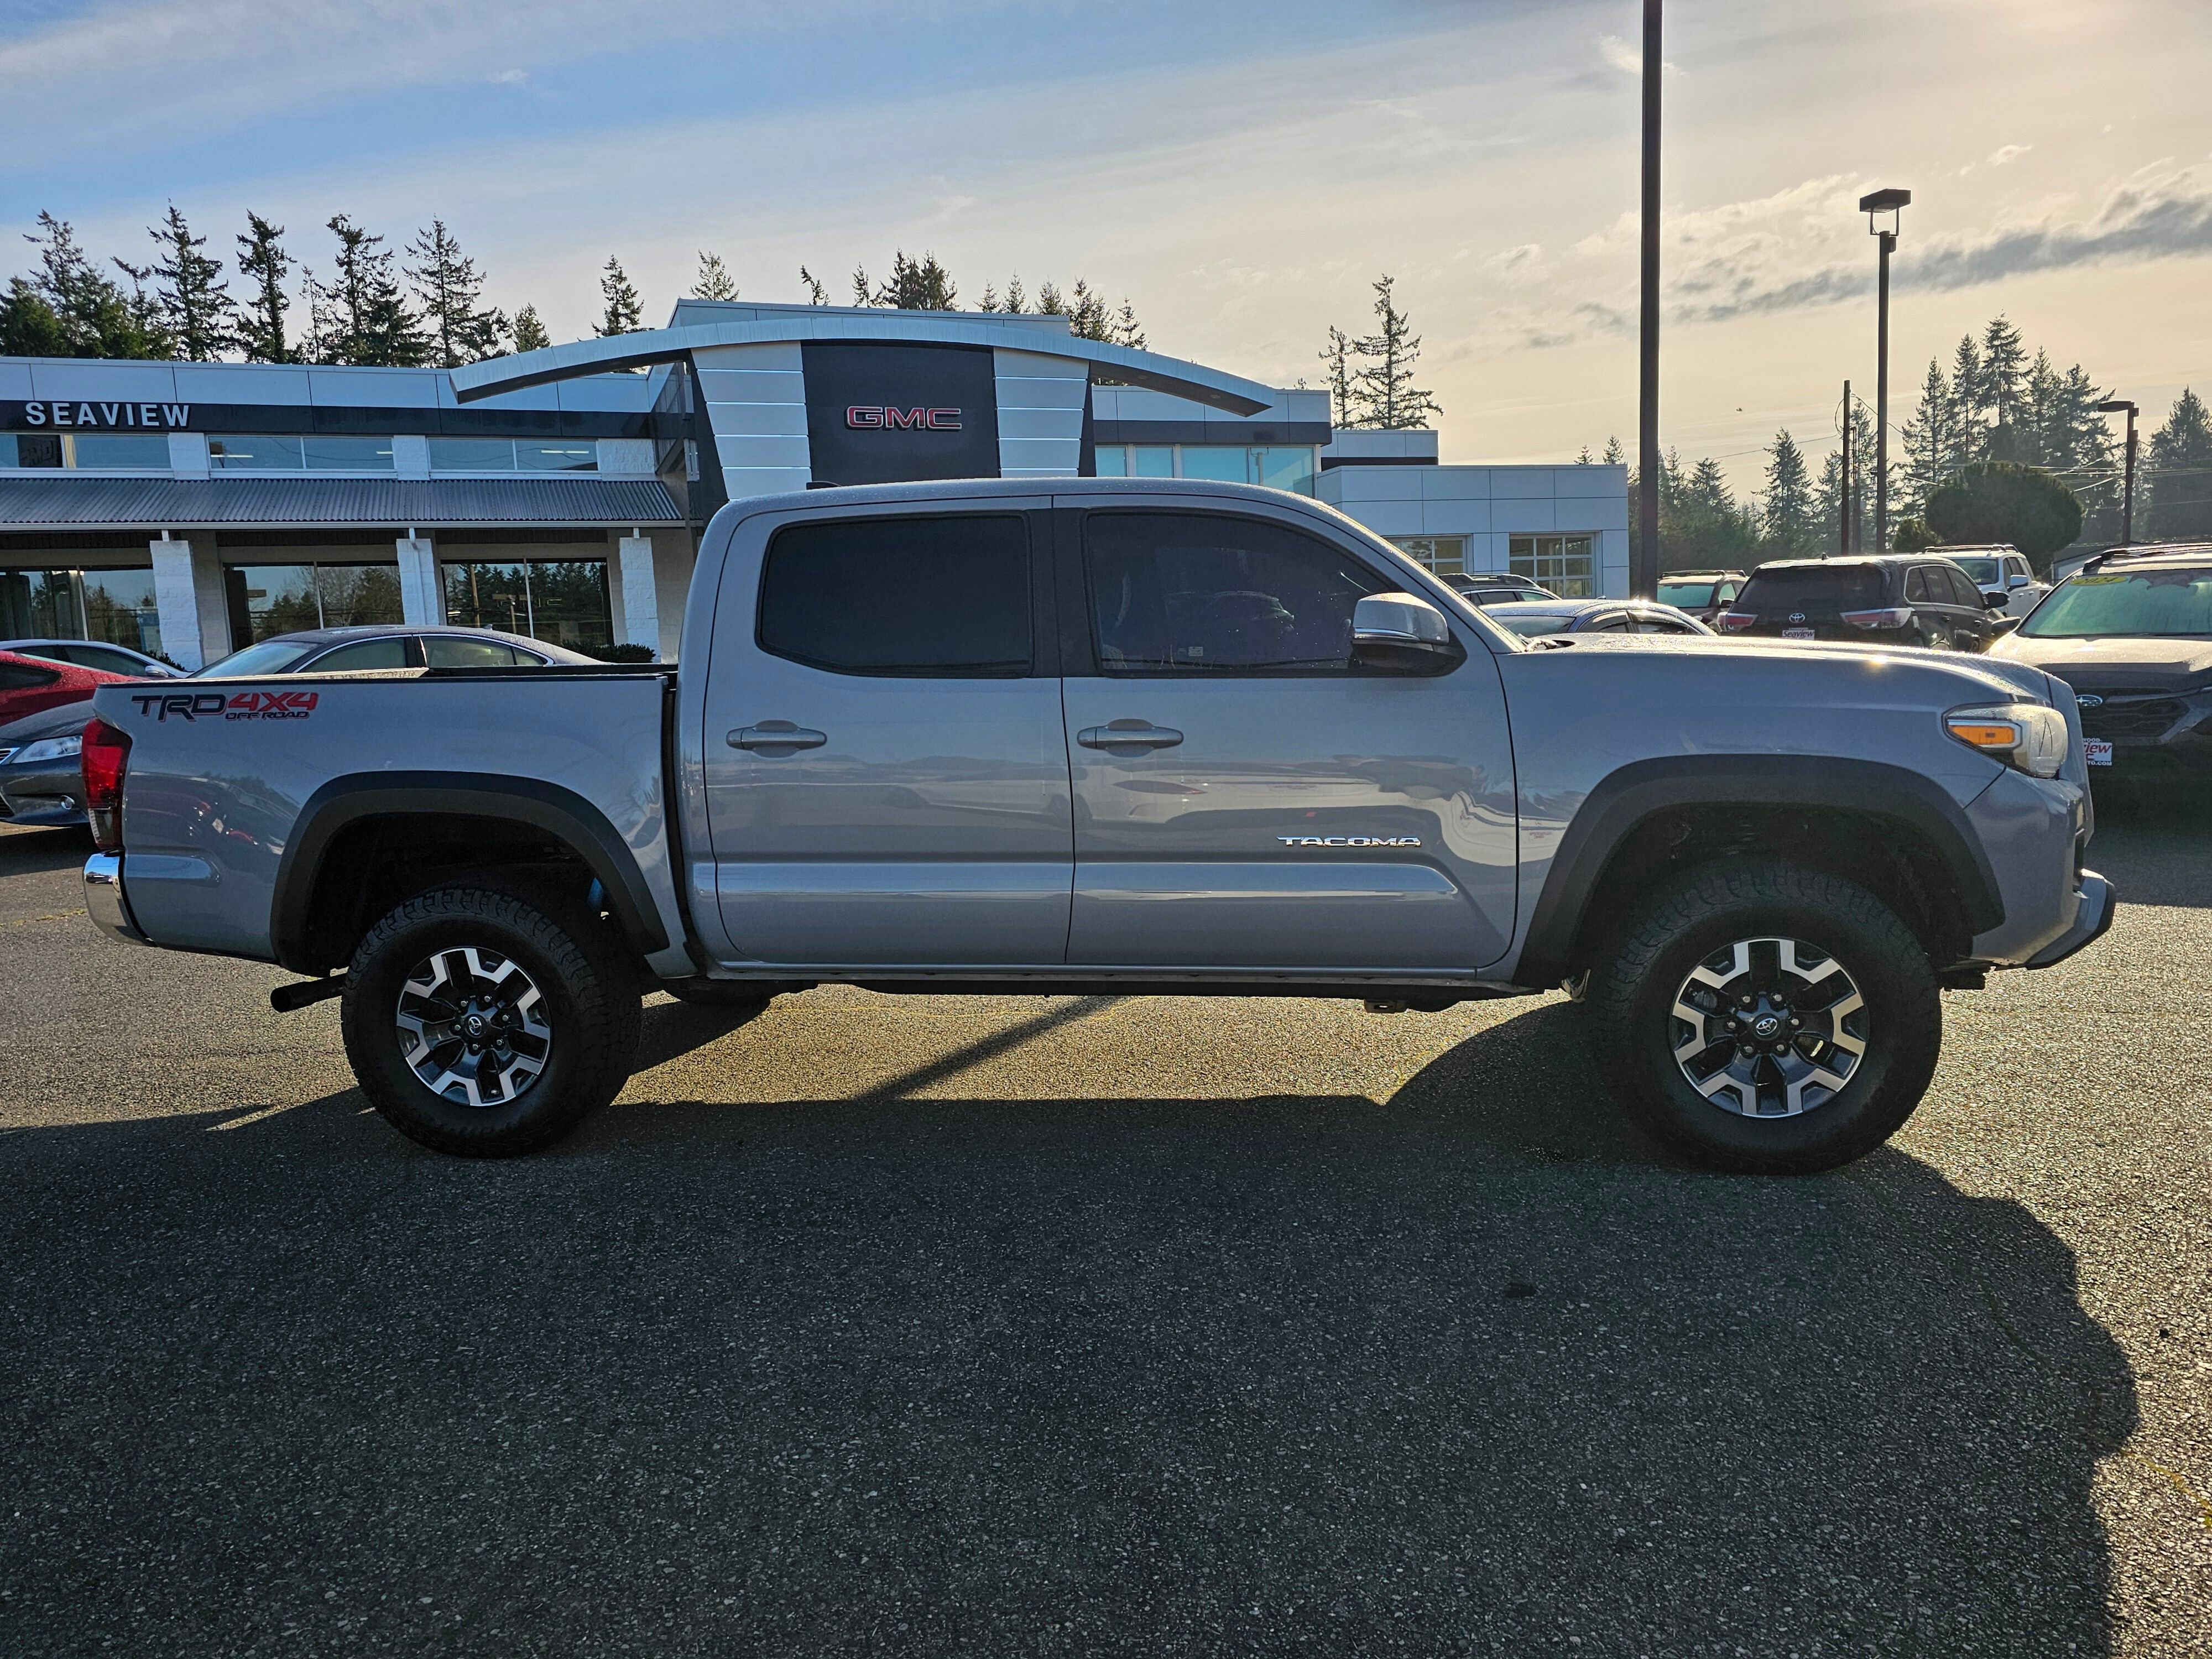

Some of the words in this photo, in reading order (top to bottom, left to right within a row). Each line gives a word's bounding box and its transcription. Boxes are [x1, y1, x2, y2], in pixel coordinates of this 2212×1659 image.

[25, 401, 190, 427] SEAVIEW
[846, 406, 962, 430] GMC
[1783, 629, 1814, 638] Seaview
[225, 712, 260, 721] OFF
[261, 711, 309, 720] ROAD
[1277, 837, 1421, 847] TACOMA
